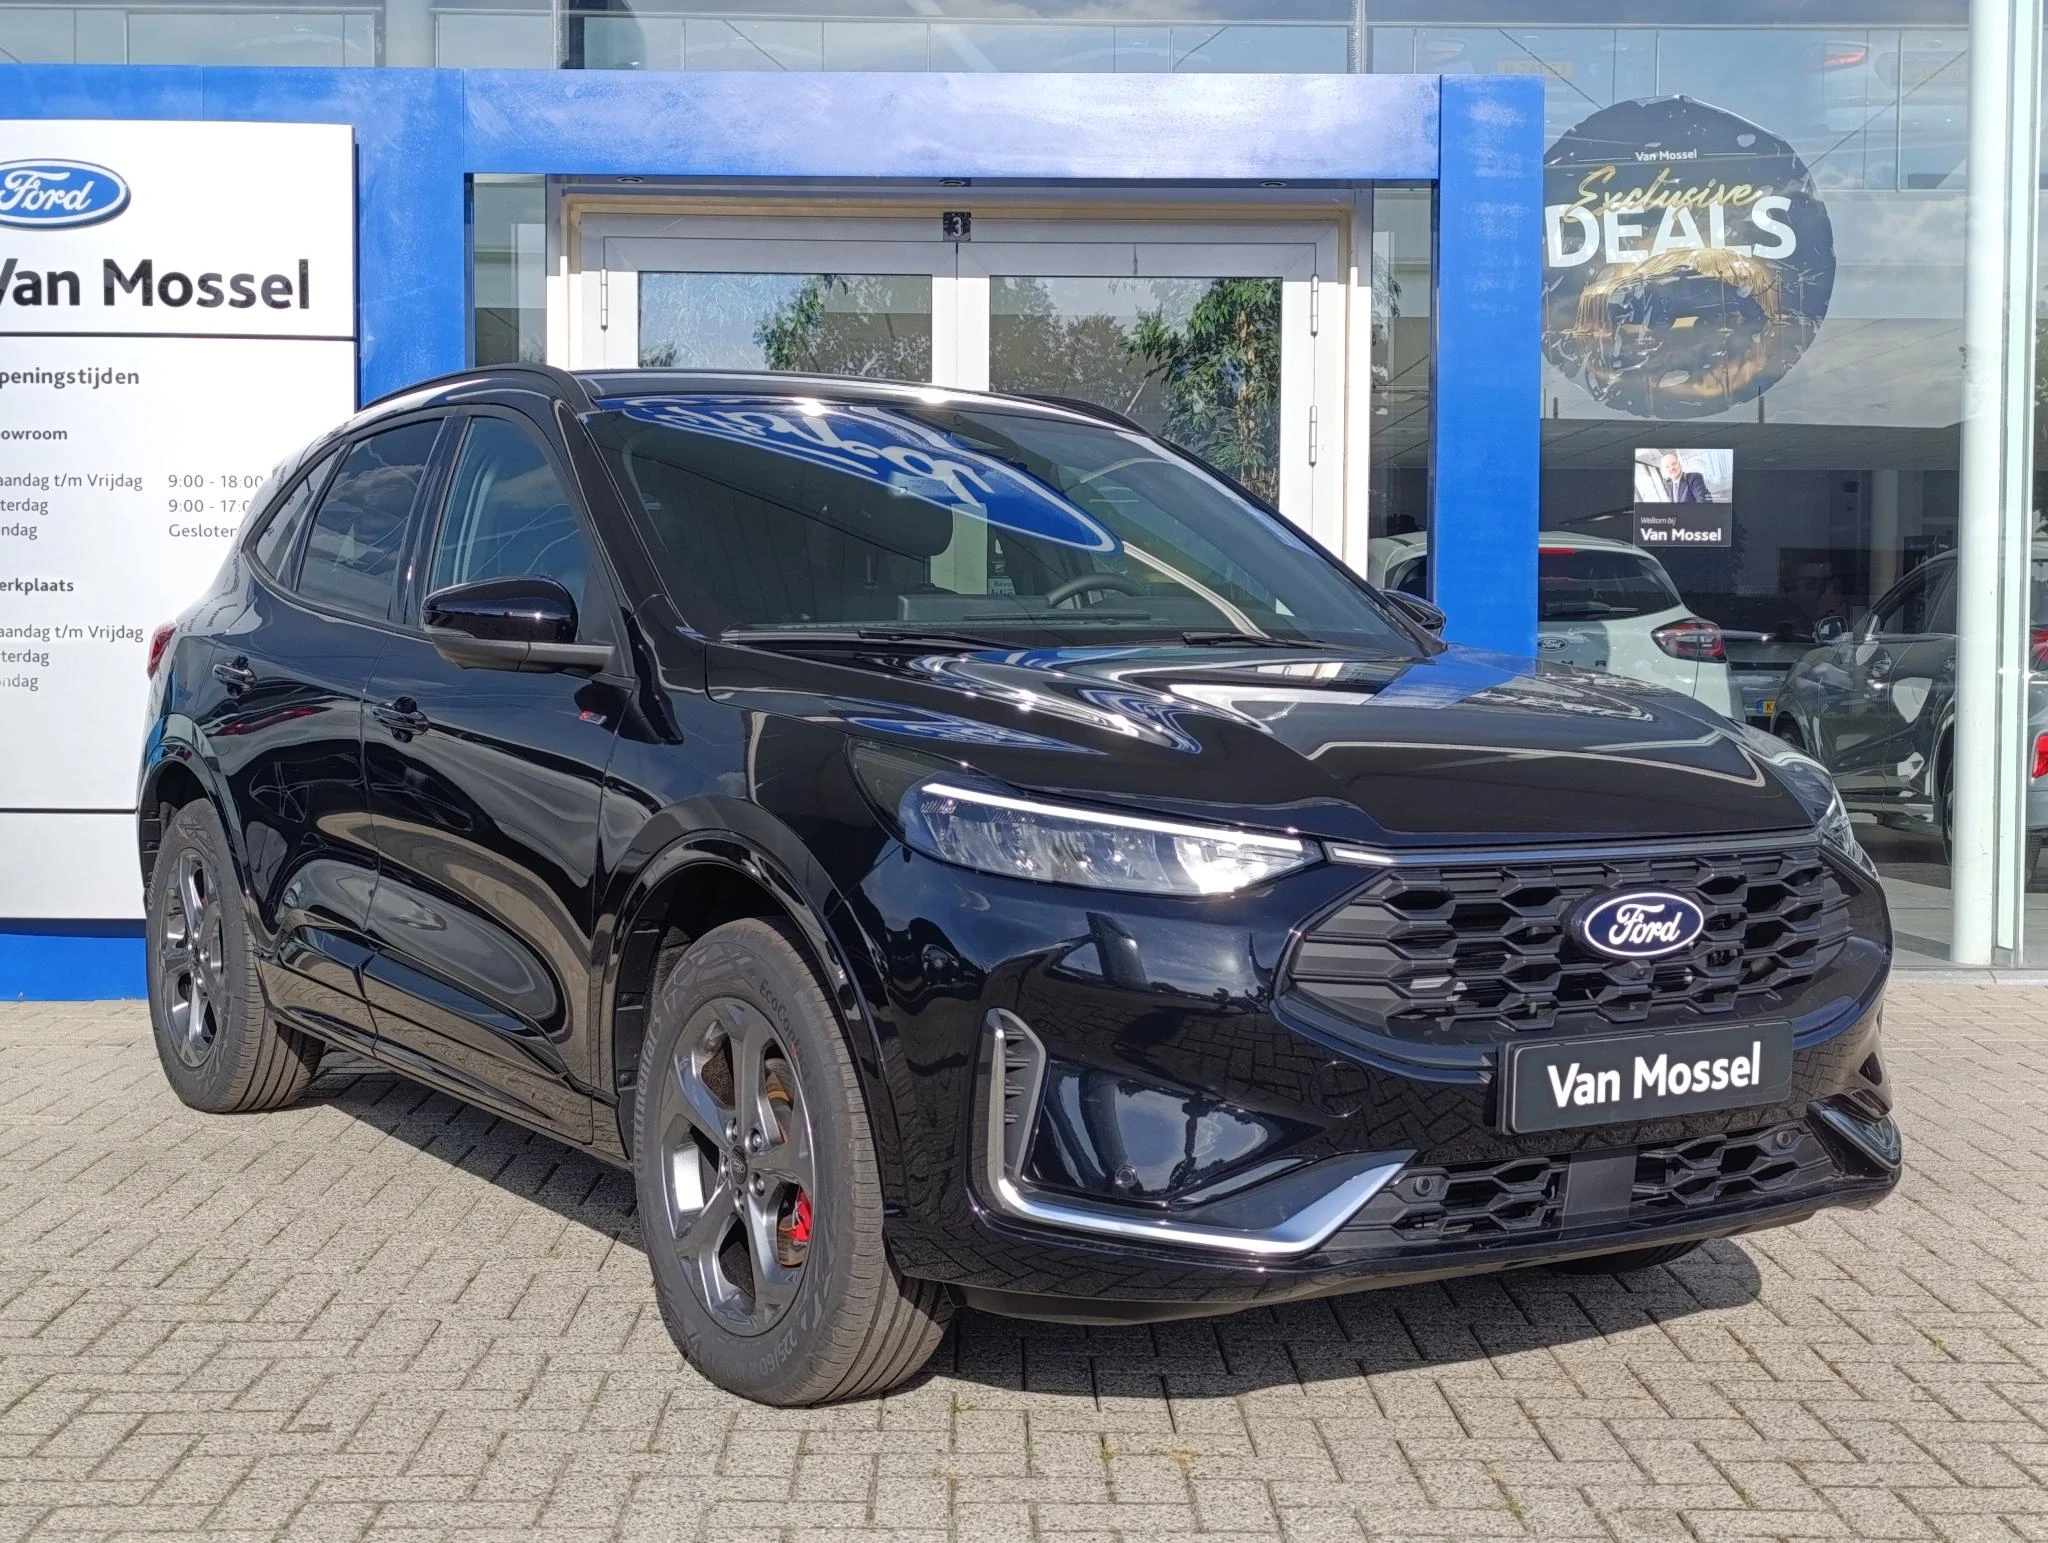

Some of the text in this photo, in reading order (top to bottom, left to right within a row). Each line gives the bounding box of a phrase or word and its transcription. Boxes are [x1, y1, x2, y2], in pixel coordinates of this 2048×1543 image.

[1635, 148, 1698, 162] Van Mossel
[0, 170, 95, 211] Ford
[1564, 165, 1766, 224] Exclusive
[952, 216, 962, 237] 3
[1544, 195, 1798, 268] DEALS
[103, 258, 310, 310] Mossel
[0, 366, 140, 390] peningstijden
[54, 473, 82, 487] t/m
[87, 473, 143, 491] Vrijdag
[168, 474, 204, 488] 9:00
[168, 499, 204, 513] 9:00
[1640, 516, 1677, 526] Welkom bij
[1640, 527, 1722, 541] Van Mossel
[0, 577, 74, 596] erkplaats
[55, 624, 83, 639] t/m
[88, 624, 144, 643] Vrijdag
[1541, 639, 1562, 648] Ford
[1608, 903, 1682, 944] Ford
[1547, 1040, 1761, 1108] Van Mossel
